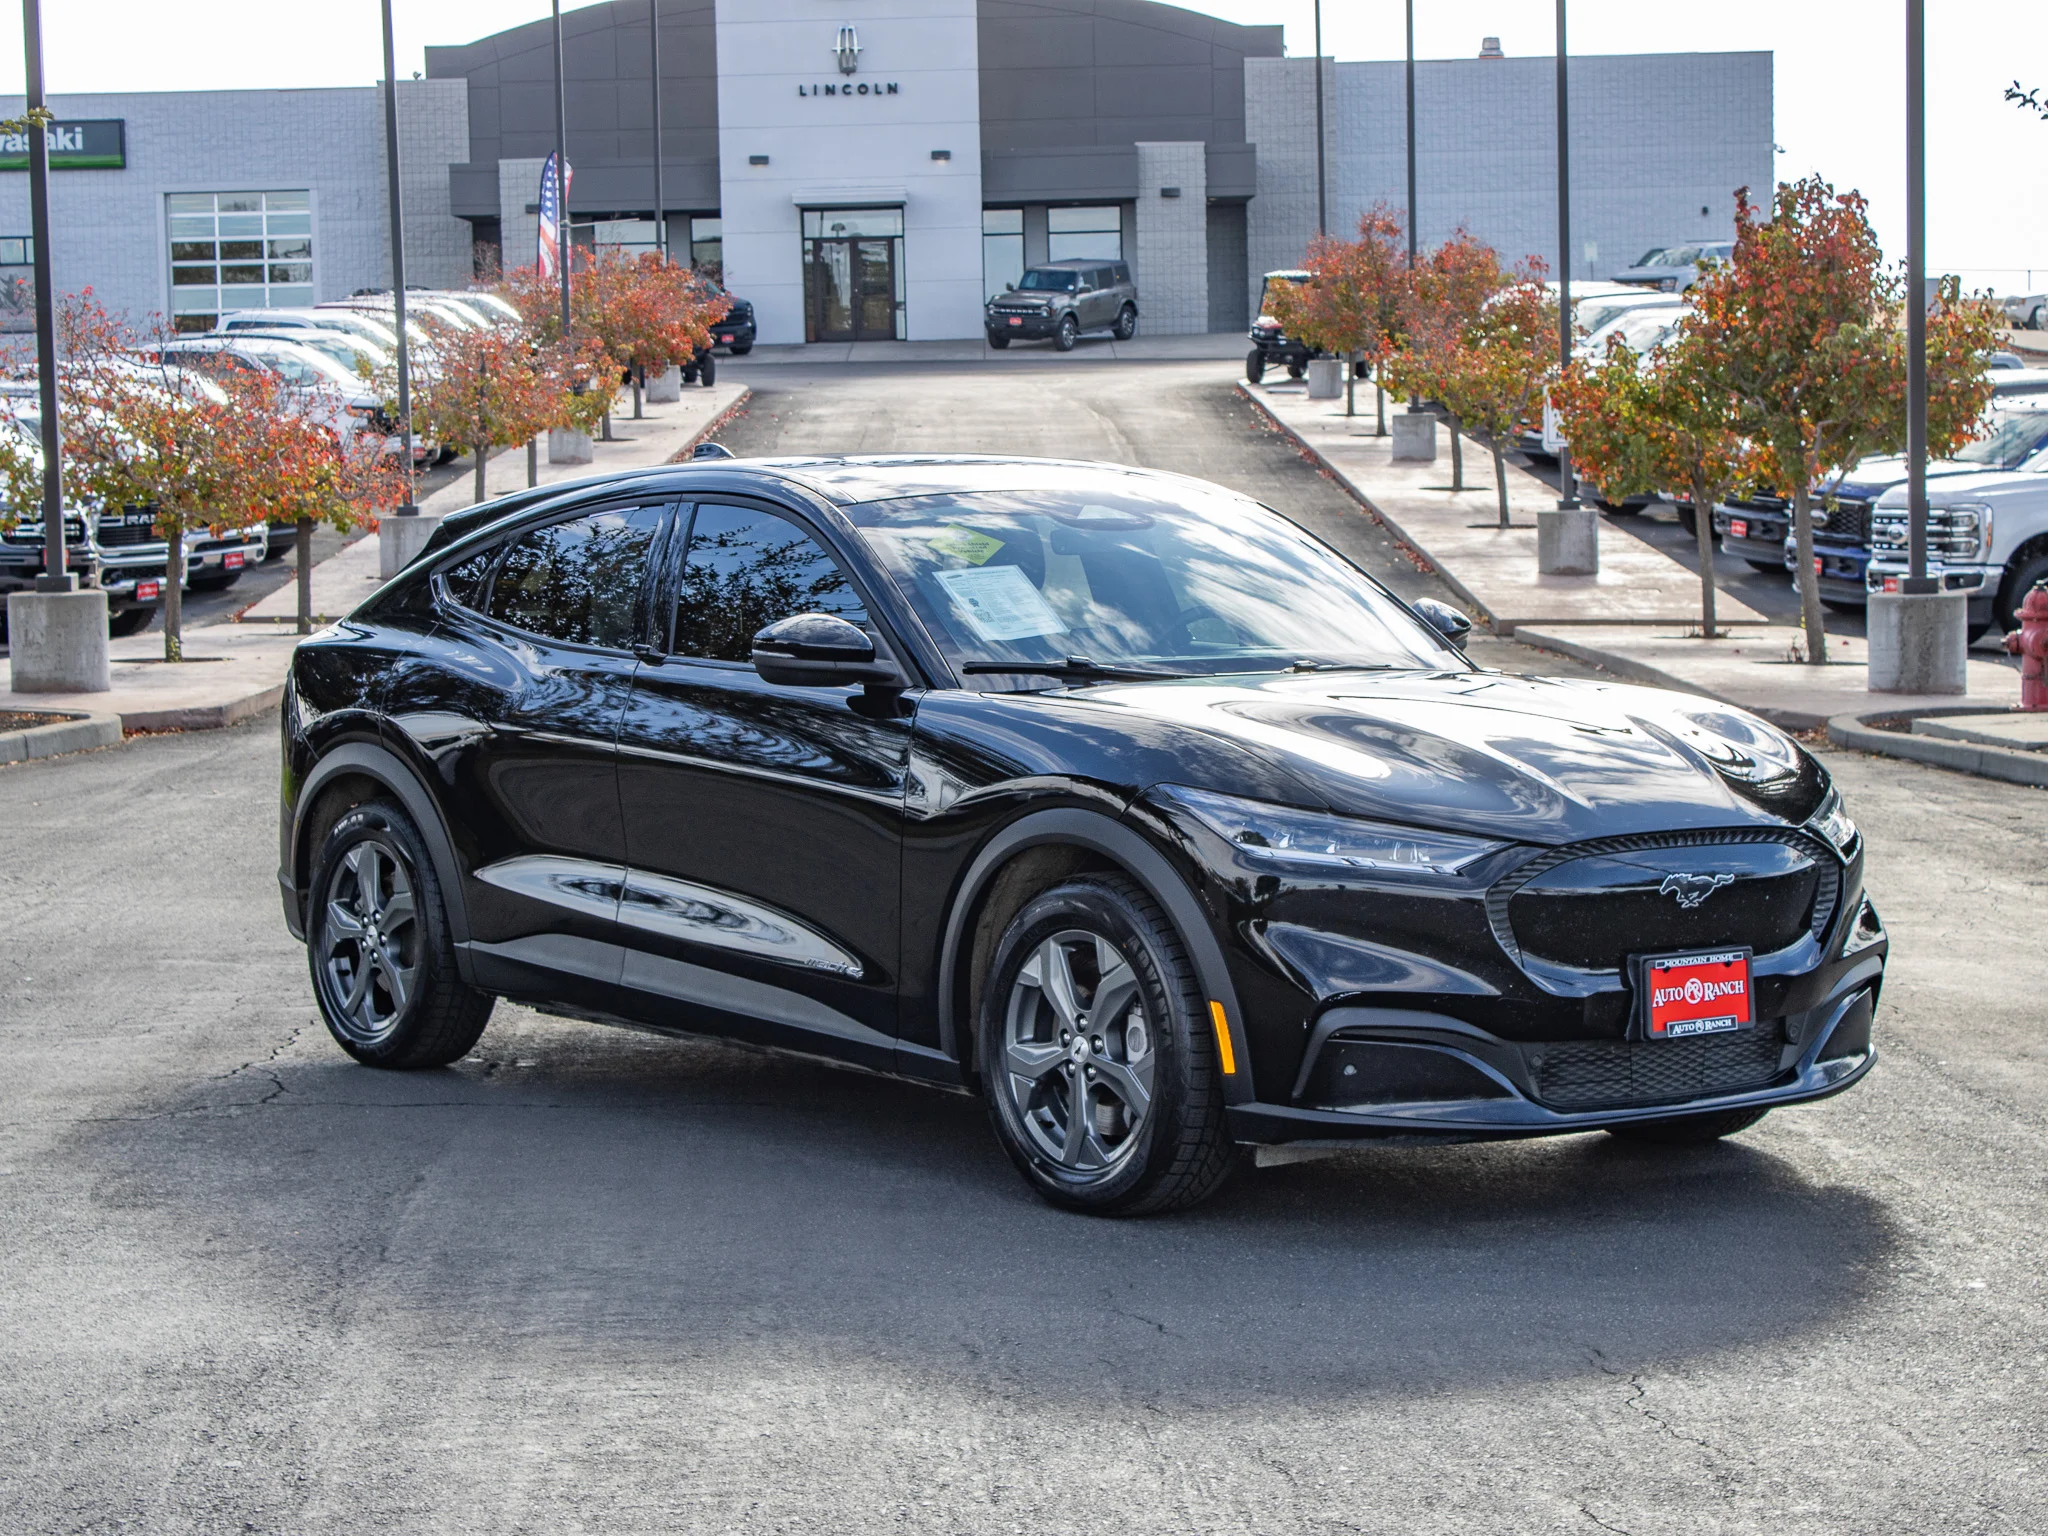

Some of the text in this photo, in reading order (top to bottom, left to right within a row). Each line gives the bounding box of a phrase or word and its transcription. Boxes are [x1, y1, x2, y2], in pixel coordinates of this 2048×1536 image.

[799, 82, 898, 97] LINCOLN
[0, 127, 83, 152] aaki
[1664, 953, 1734, 967] MOUNTAIN HOME
[1652, 986, 1684, 1007] AUTO
[1704, 980, 1744, 1002] RANCH
[1672, 1018, 1732, 1034] AUTO RANCH
